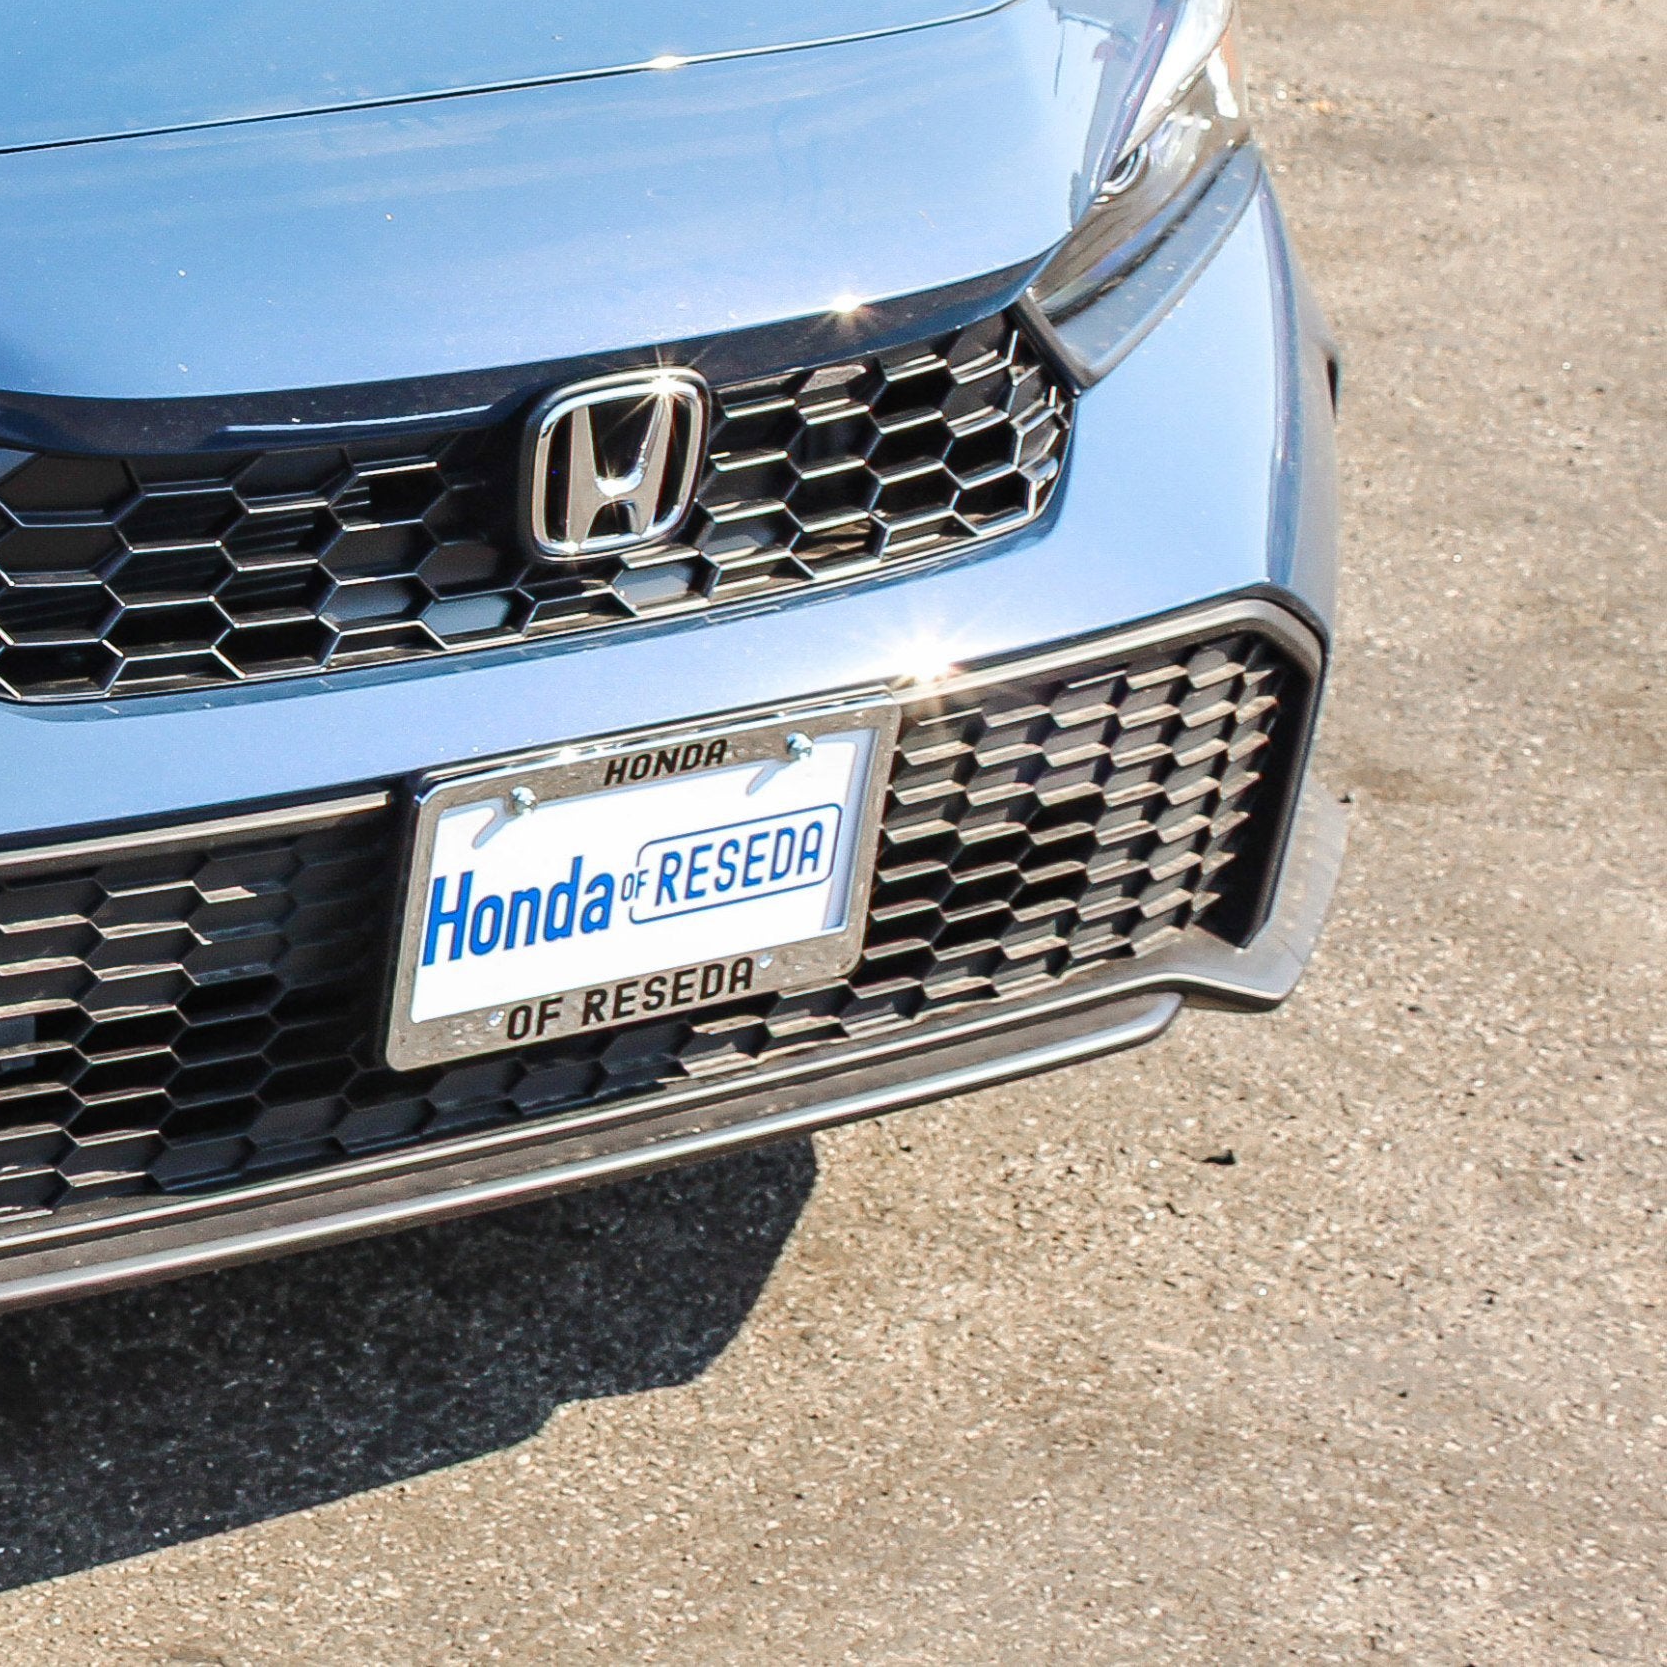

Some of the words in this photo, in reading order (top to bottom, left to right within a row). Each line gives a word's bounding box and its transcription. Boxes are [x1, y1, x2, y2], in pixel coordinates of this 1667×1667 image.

[603, 738, 728, 786] HONDA
[421, 855, 614, 967] Honda
[620, 868, 650, 902] OF
[655, 820, 823, 906] RESEDA
[507, 996, 563, 1041] OF
[581, 956, 754, 1026] RESEDA
